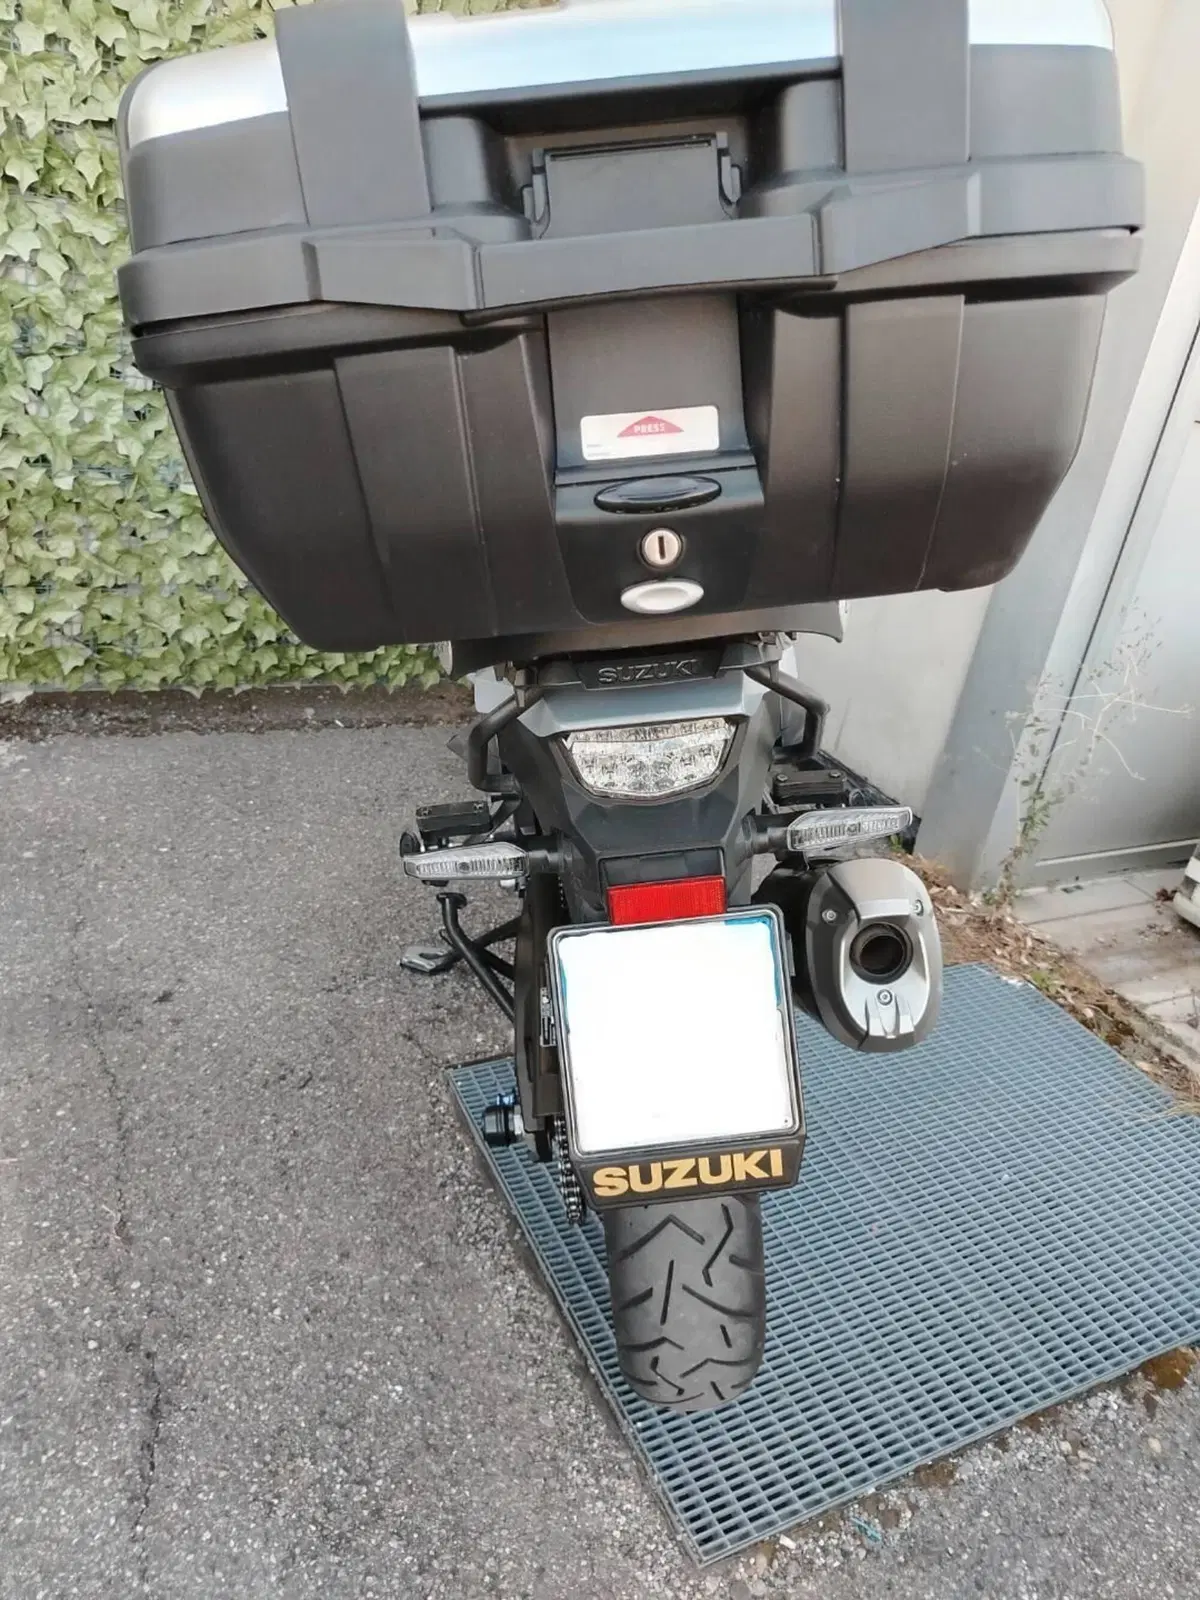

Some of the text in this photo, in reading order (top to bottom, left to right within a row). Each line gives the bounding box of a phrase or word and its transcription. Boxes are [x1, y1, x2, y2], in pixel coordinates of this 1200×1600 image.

[633, 422, 666, 435] PRESS
[598, 659, 699, 683] SUZUKI
[592, 1148, 783, 1197] SUZUKI
